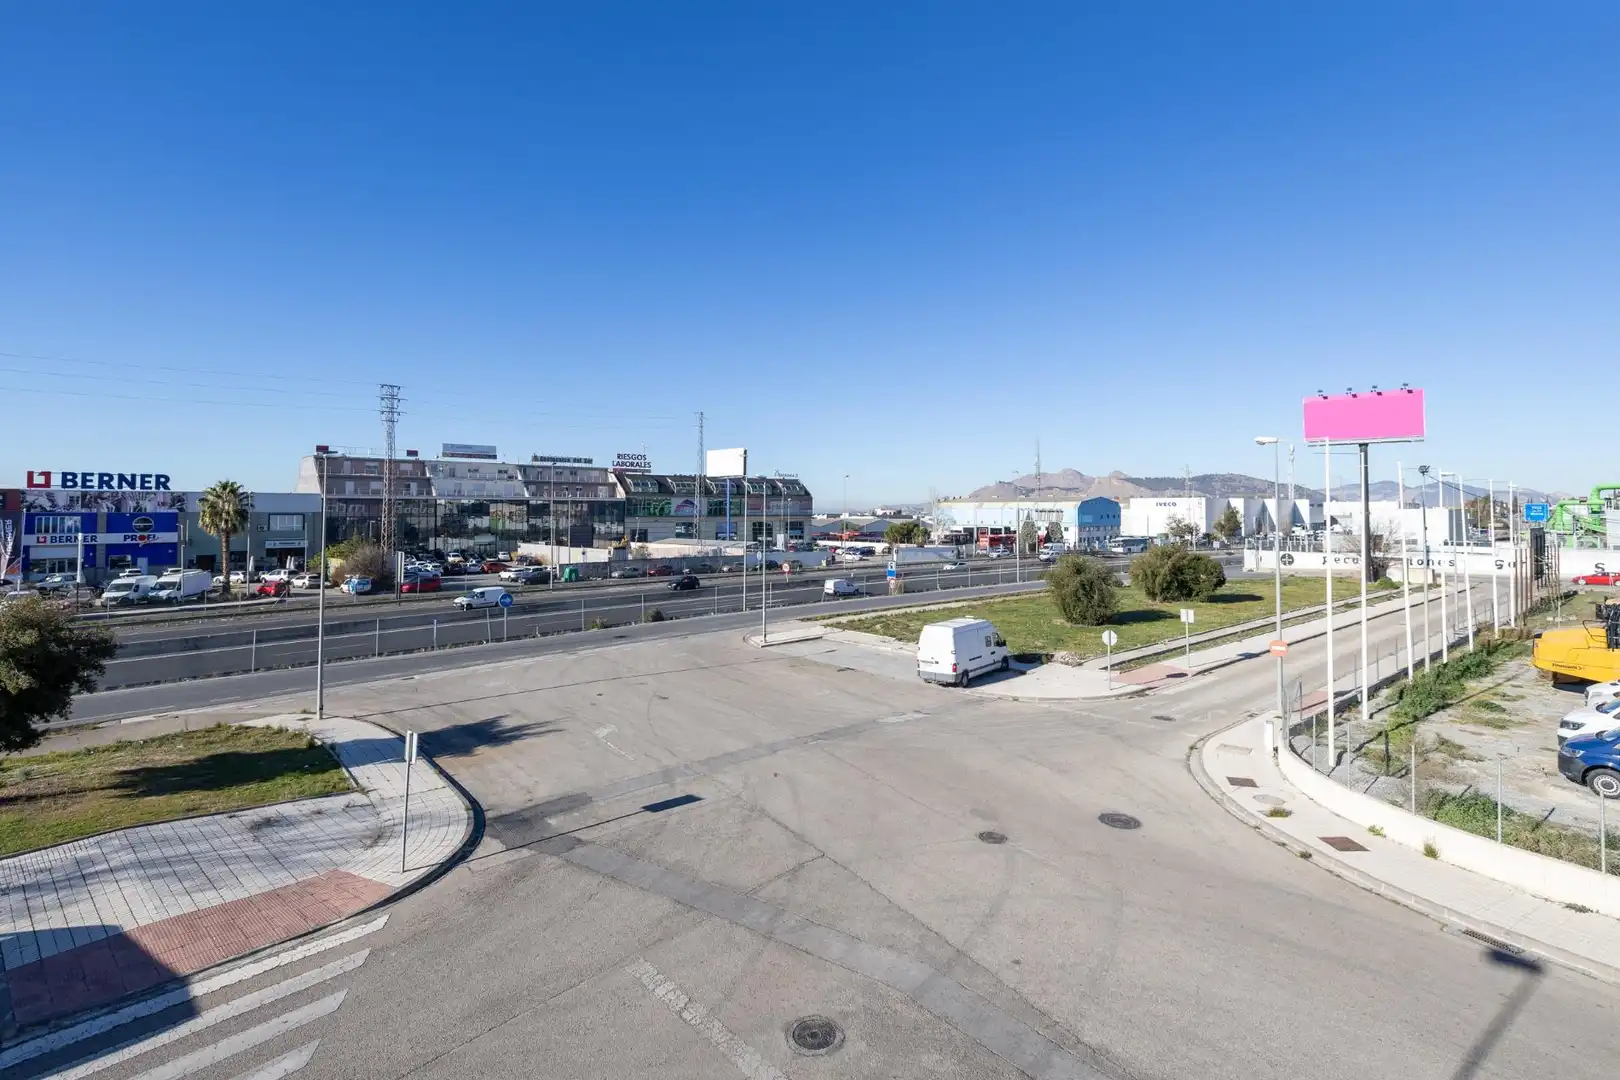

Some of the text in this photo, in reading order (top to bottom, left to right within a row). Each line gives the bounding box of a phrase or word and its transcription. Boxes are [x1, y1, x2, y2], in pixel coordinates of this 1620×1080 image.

[617, 453, 647, 461] RIESGOS
[61, 472, 171, 490] BERNER
[50, 534, 98, 543] BERNER
